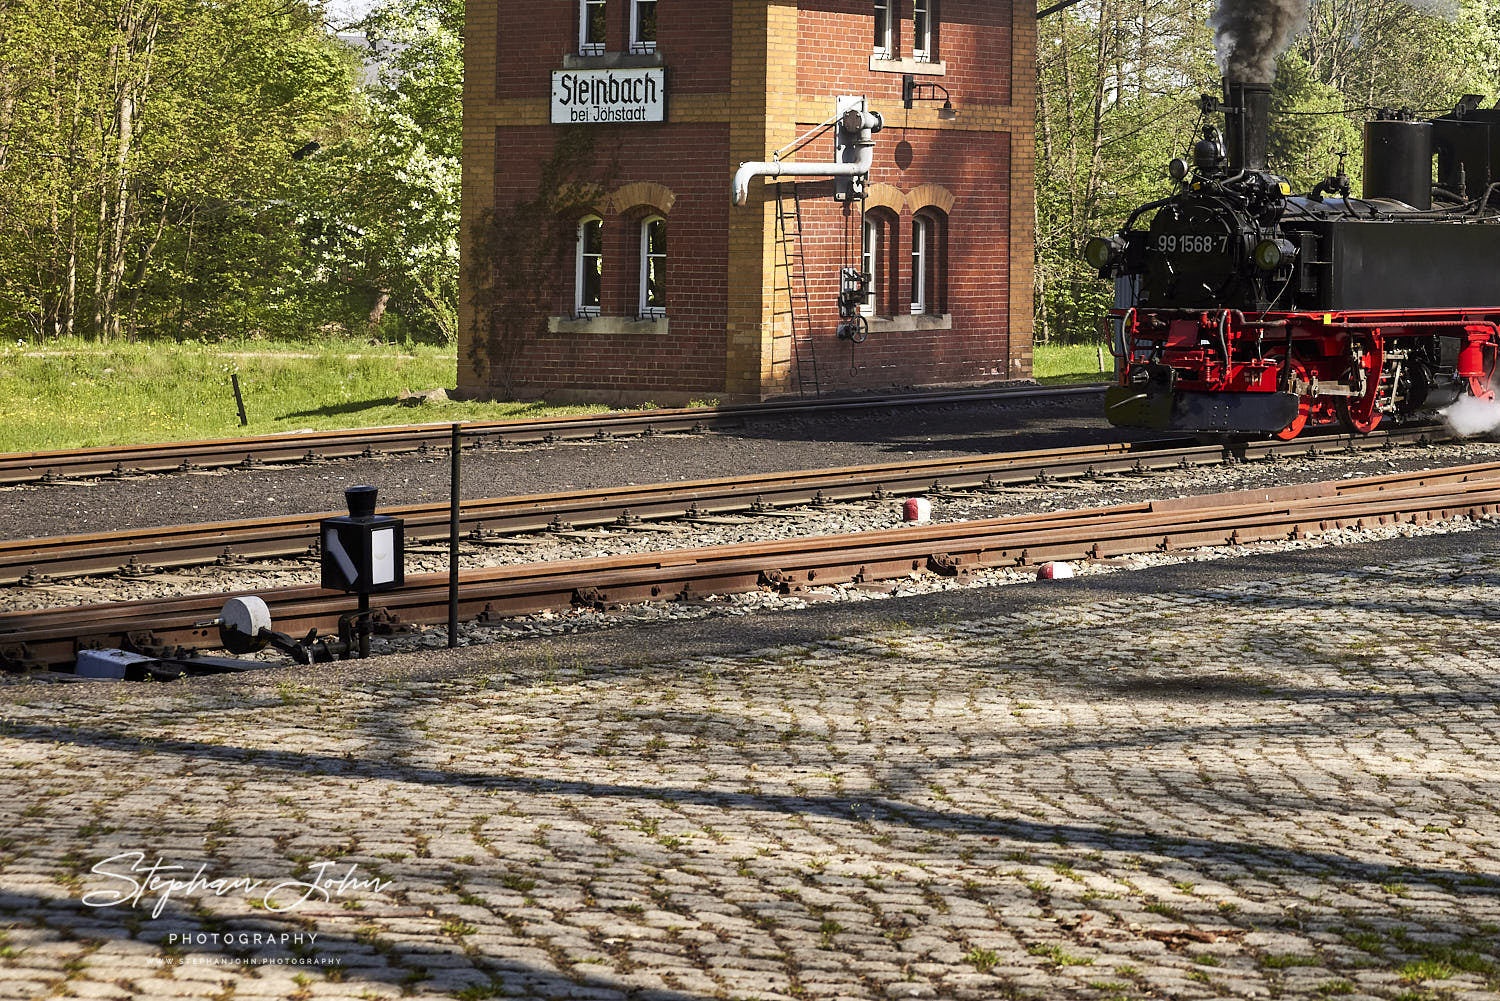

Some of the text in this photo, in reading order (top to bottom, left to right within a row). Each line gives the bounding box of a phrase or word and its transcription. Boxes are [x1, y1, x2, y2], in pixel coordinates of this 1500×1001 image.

[559, 72, 657, 106] Steinbach
[570, 106, 646, 122] bei Jöhstadt
[1158, 235, 1177, 252] 99
